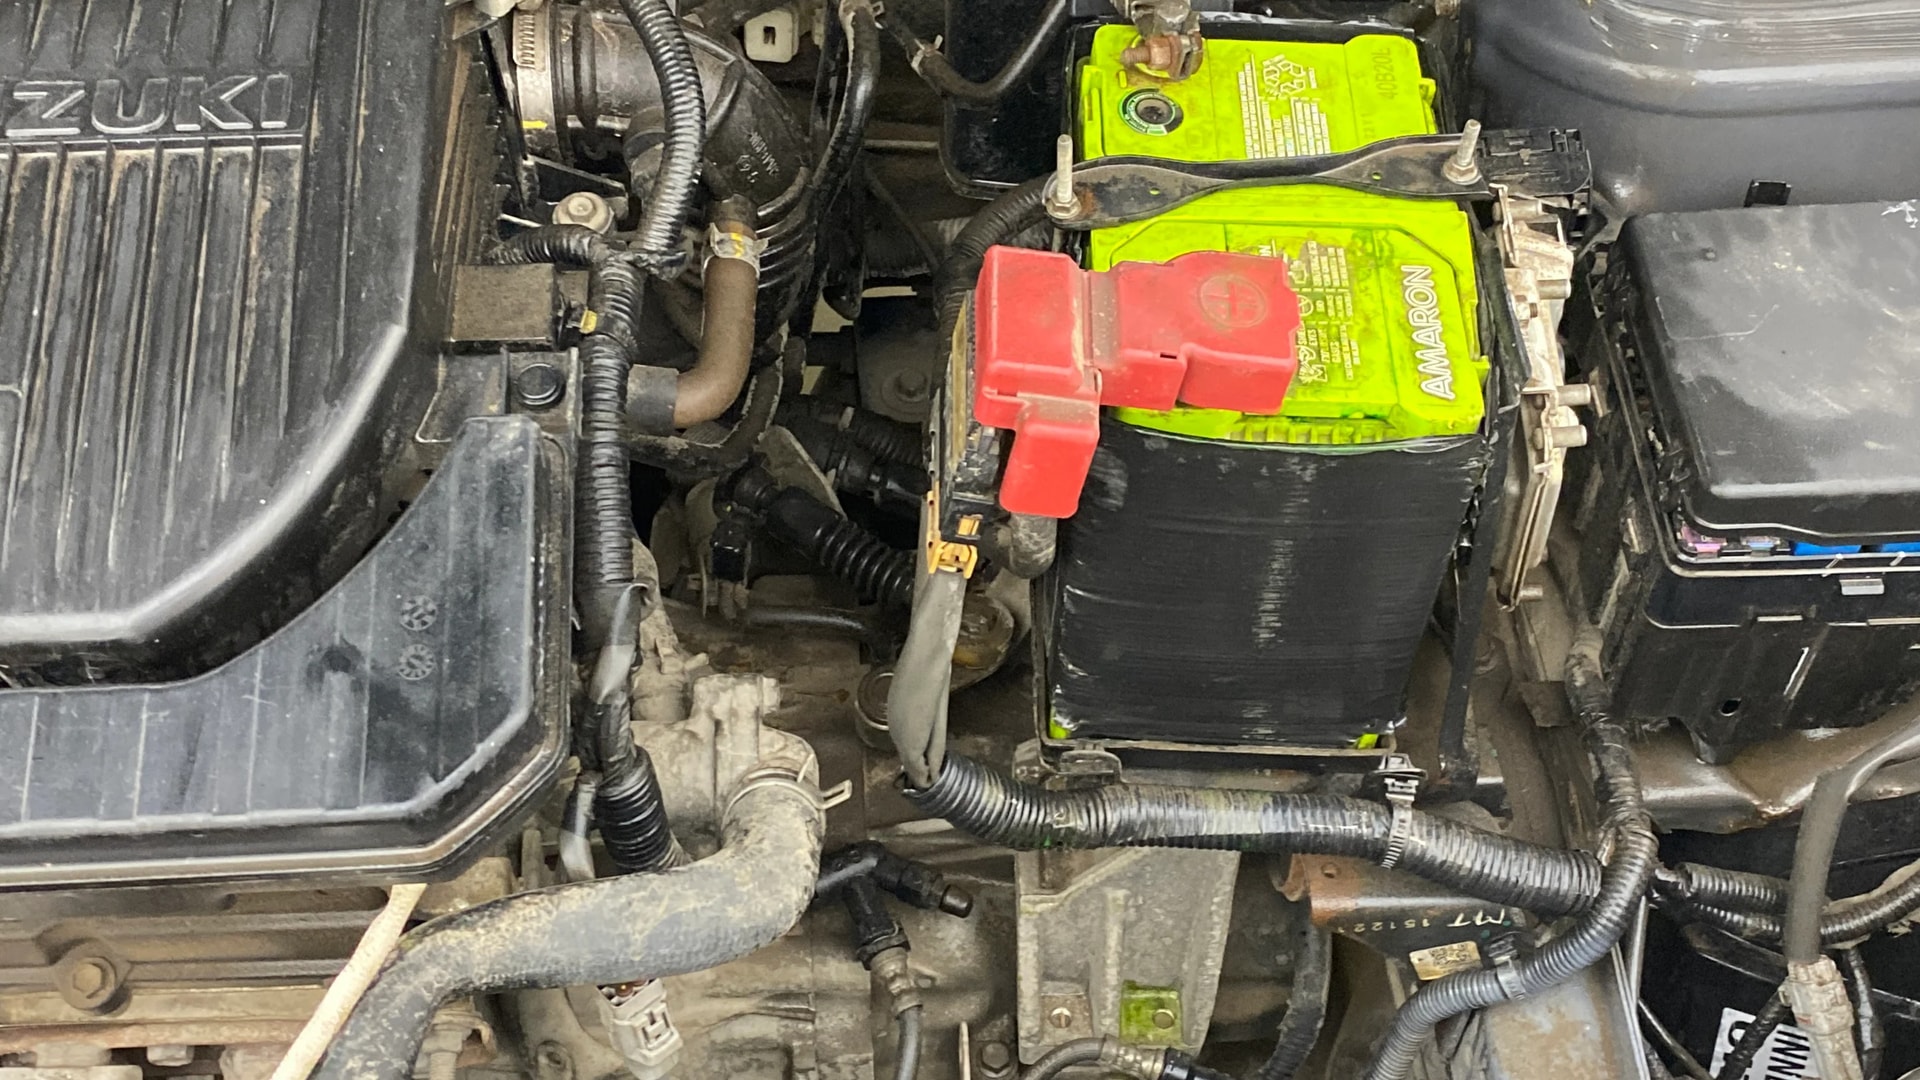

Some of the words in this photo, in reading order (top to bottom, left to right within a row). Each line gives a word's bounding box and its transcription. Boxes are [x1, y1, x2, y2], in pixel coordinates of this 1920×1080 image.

[0, 75, 292, 136] ZUKI
[1401, 264, 1456, 400] AMARON
[1765, 1030, 1811, 1080] INN
